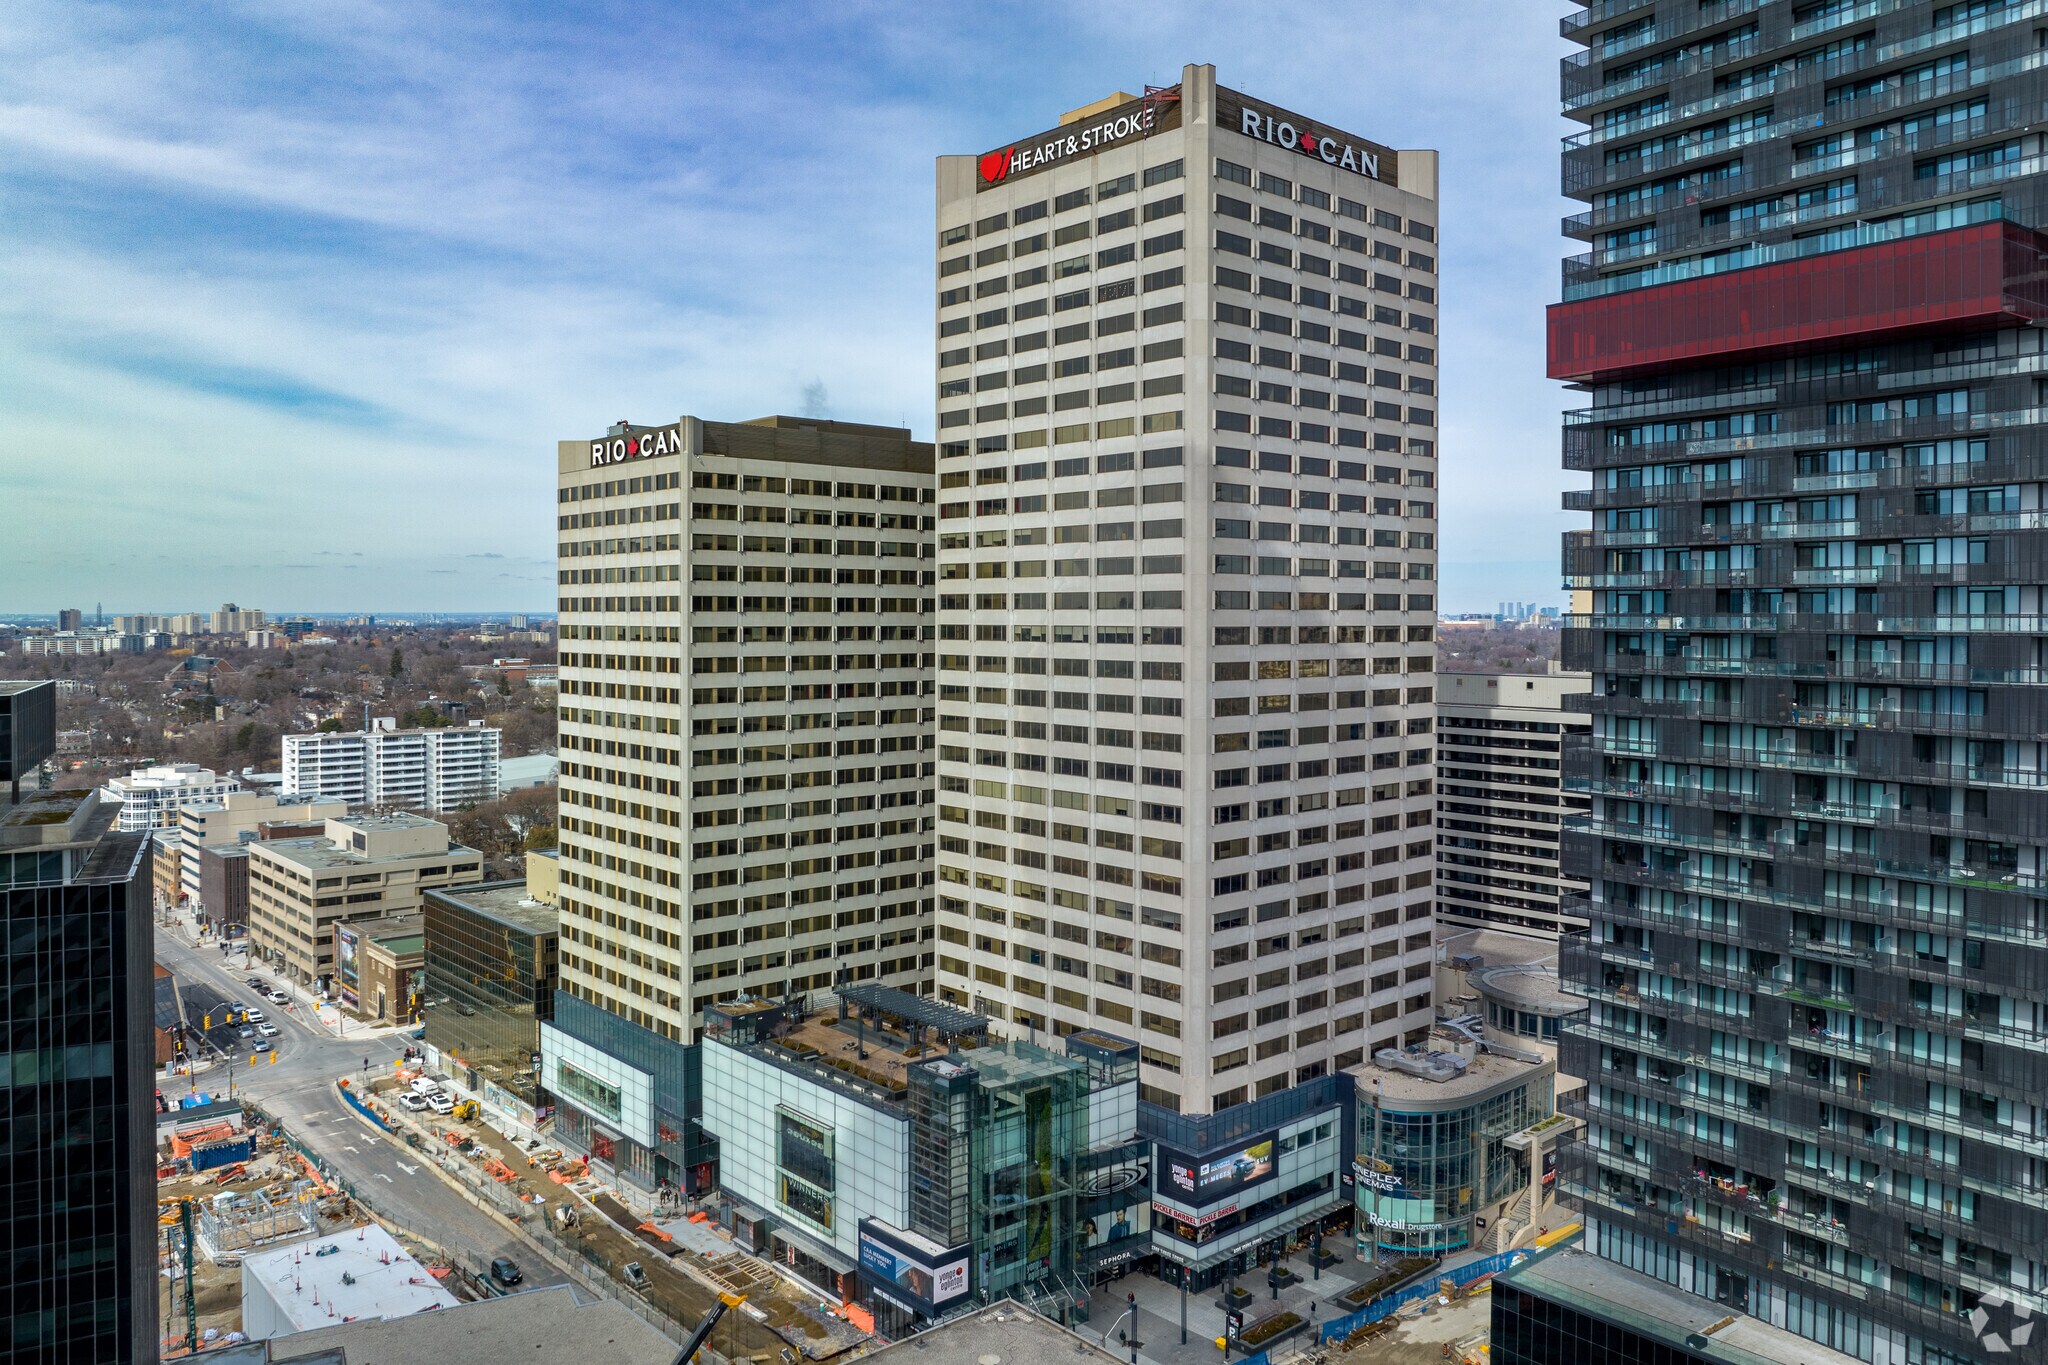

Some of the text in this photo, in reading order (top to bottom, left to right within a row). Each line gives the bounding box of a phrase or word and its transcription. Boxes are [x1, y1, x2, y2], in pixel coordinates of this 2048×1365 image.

[1010, 138, 1065, 174] HEART
[1081, 108, 1154, 150] STROKE
[1241, 107, 1379, 180] RIO CAN
[592, 429, 681, 466] RIO CAN
[1351, 1161, 1402, 1186] CINEPLEX
[1355, 1172, 1394, 1192] CINEMAS
[788, 1177, 830, 1203] WINNERS
[1153, 1202, 1197, 1225] PICKLE BARREL
[1199, 1204, 1238, 1225] PICKLE BARREL
[1369, 1211, 1442, 1232] Rexall Drugstore
[863, 1246, 872, 1255] CAA
[872, 1249, 892, 1265] MEMBER?
[863, 1252, 877, 1263] LUCKY
[1099, 1251, 1131, 1266] SEPHORA
[939, 1269, 956, 1284] yonge
